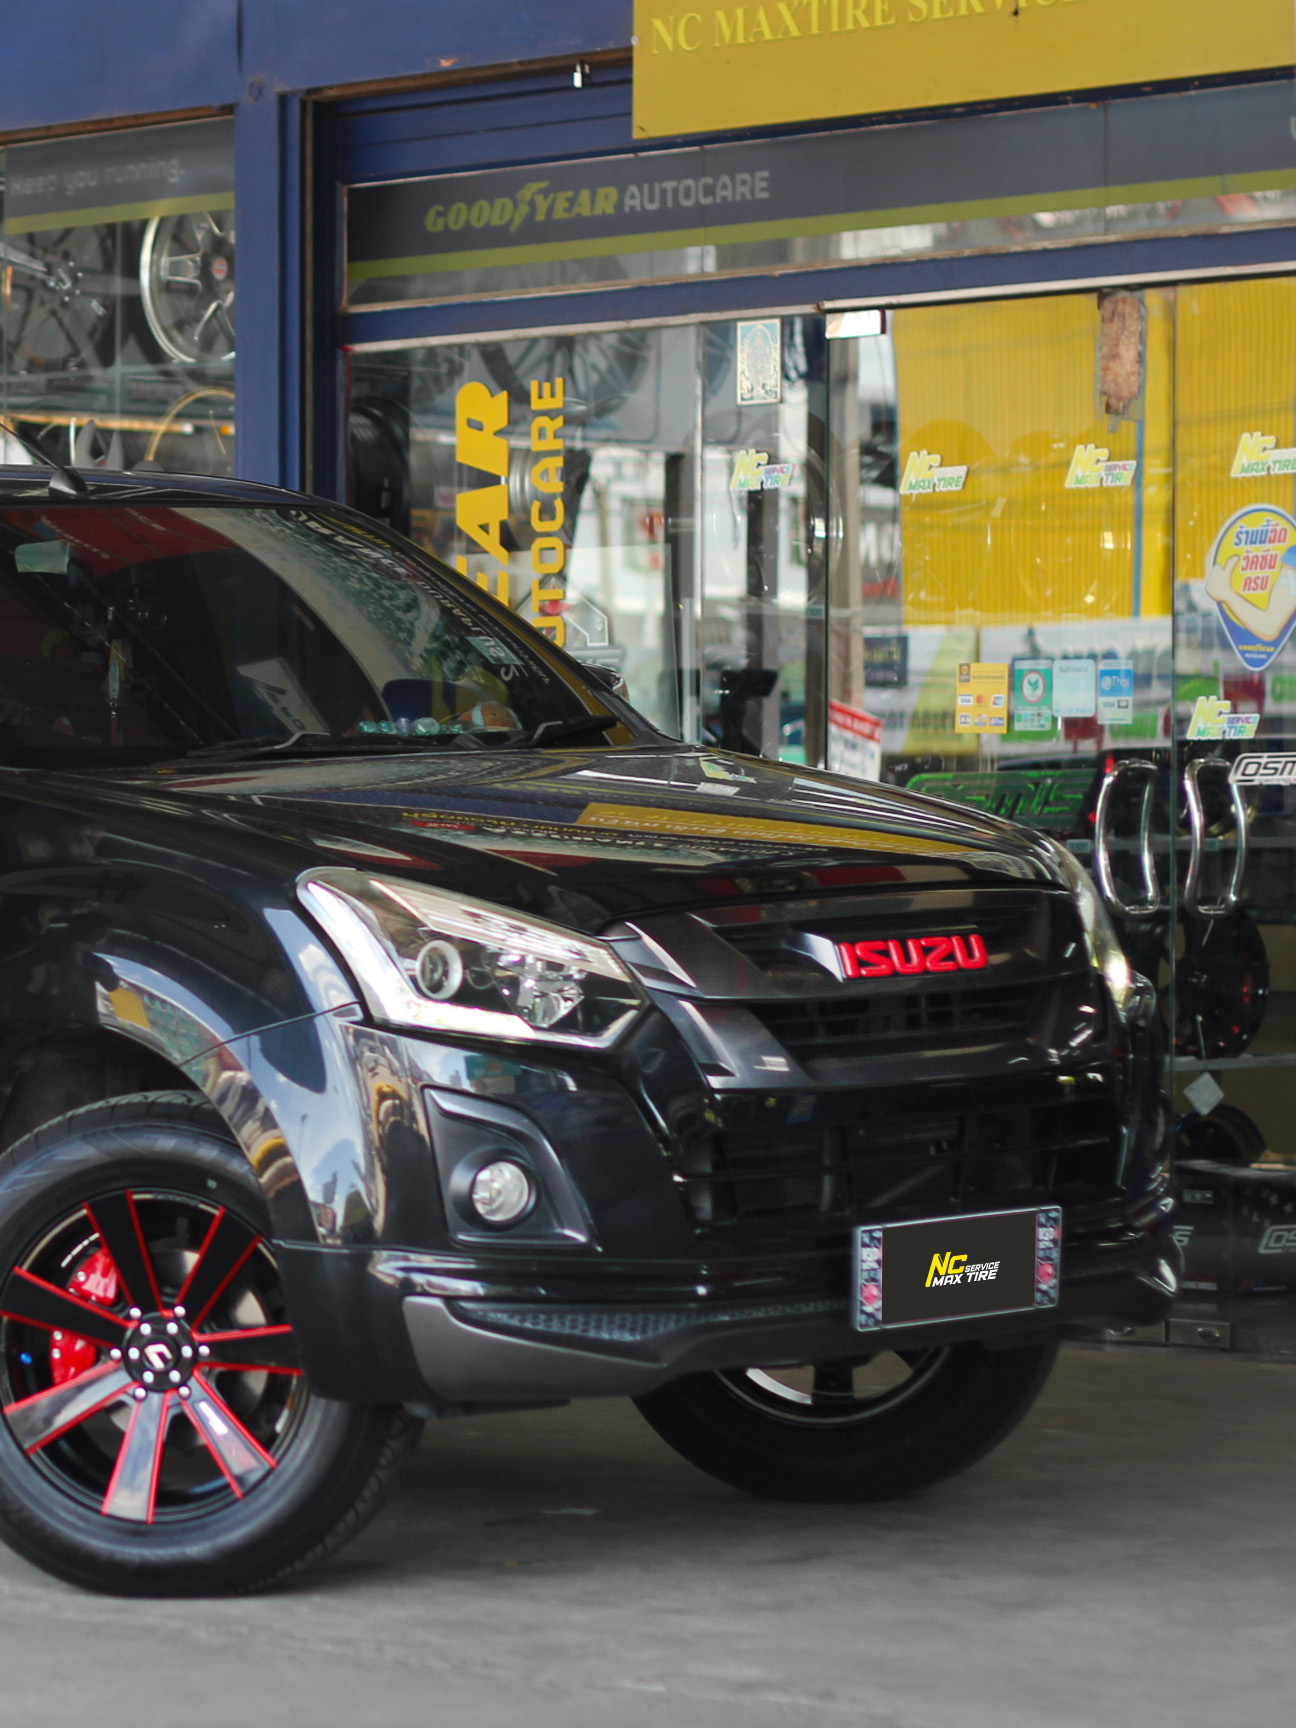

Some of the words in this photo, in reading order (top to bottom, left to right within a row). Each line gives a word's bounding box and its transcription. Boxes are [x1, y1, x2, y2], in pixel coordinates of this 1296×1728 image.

[649, 12, 703, 55] NC
[712, 0, 896, 48] MAXTIRE
[424, 181, 618, 233] GOODYEAR
[624, 170, 770, 213] AUTOCARE
[1242, 576, 1270, 593] ครบ
[838, 933, 989, 979] ISUZU
